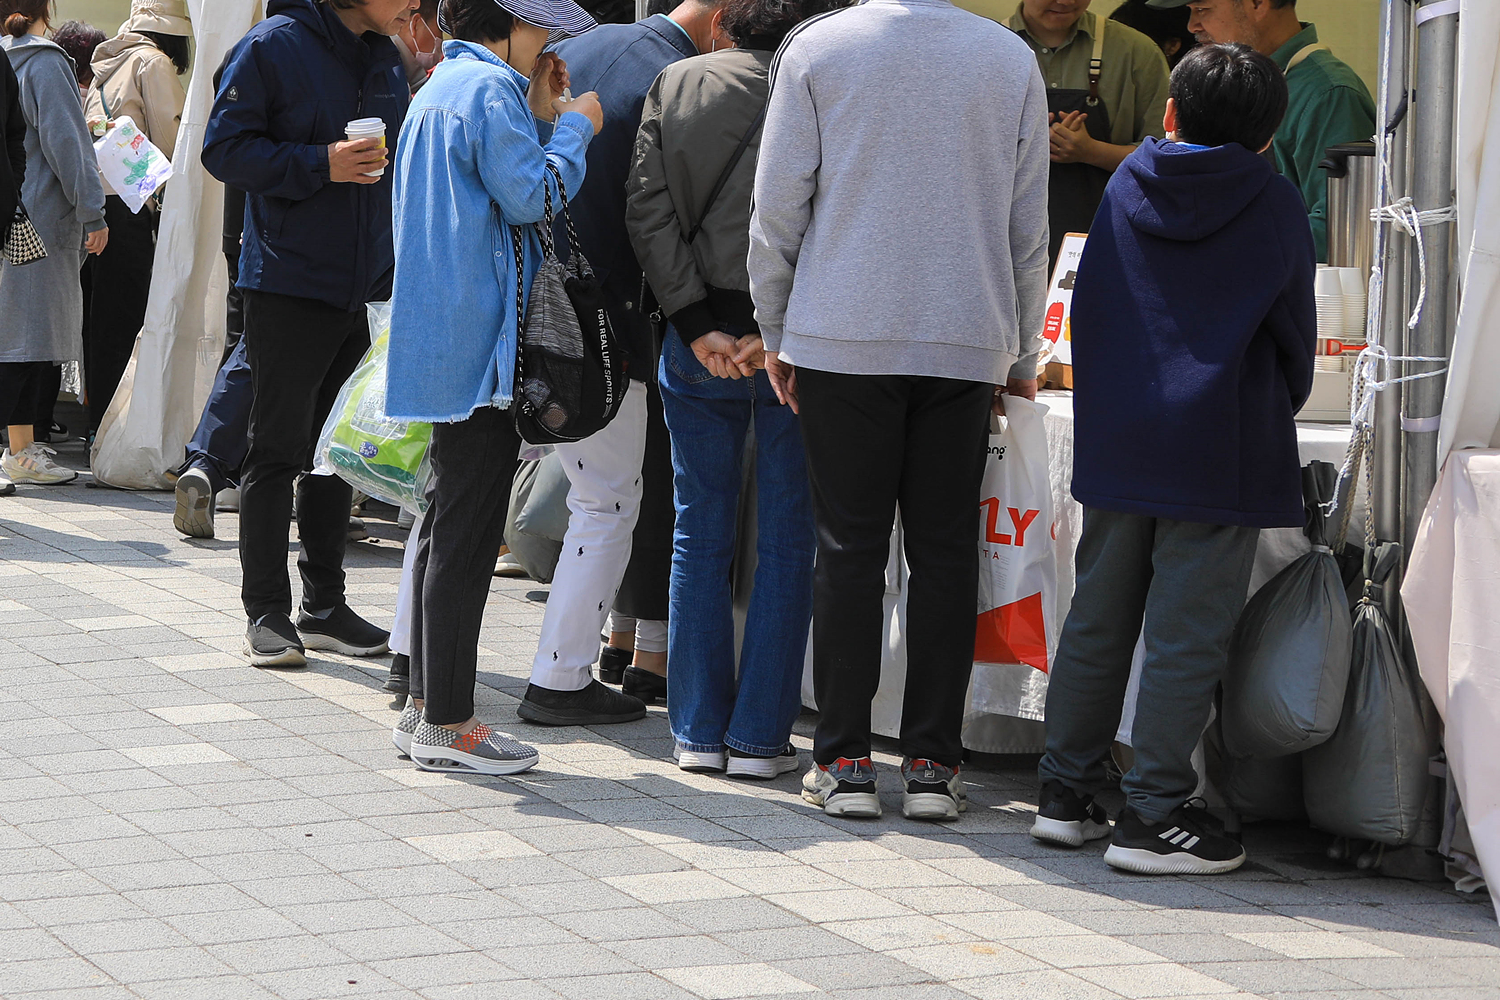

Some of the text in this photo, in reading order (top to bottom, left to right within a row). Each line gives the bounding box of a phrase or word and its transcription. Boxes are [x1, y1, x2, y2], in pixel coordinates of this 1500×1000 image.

[597, 308, 614, 405] FOR REAL LIFE SPORTS
[980, 496, 1041, 548] LY
